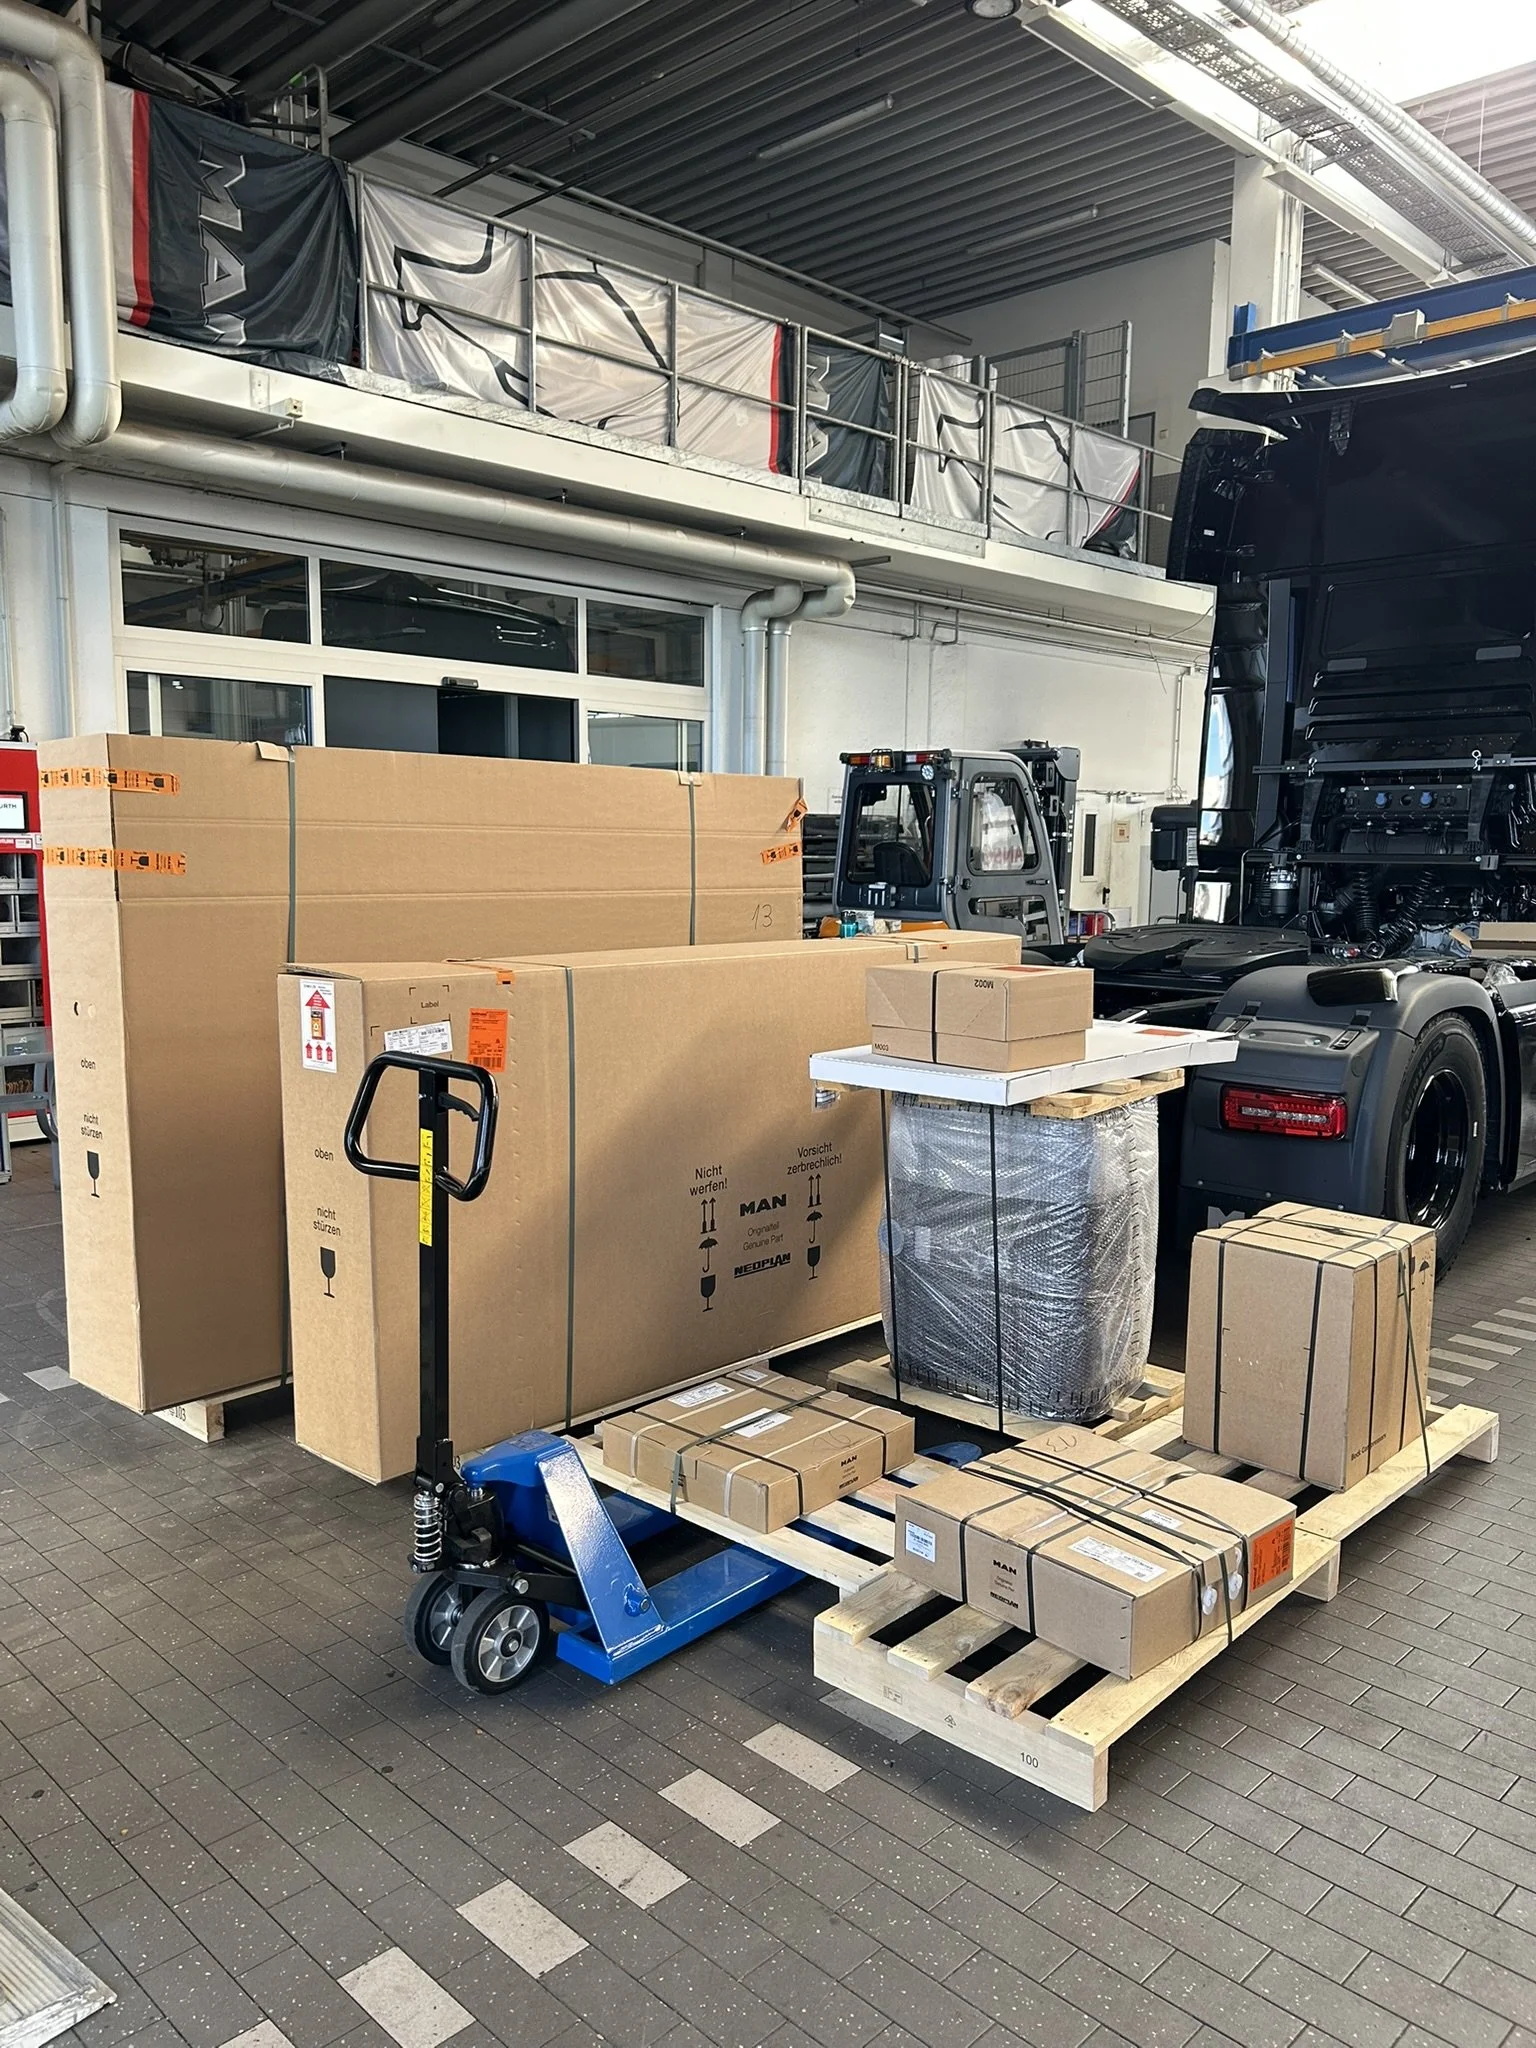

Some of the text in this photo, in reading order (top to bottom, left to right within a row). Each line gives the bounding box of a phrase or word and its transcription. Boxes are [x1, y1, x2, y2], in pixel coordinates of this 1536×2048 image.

[806, 351, 831, 476] MA
[752, 904, 773, 930] 13
[974, 979, 994, 989] M002
[420, 1000, 440, 1009] Label
[80, 1058, 96, 1070] oben
[83, 1112, 99, 1125] nicht
[81, 1125, 103, 1140] stürzen
[314, 1147, 334, 1161] oben
[797, 1142, 833, 1158] Vorsicht
[695, 1164, 723, 1180] Nicht
[787, 1153, 843, 1175] zerbrechlich!
[689, 1177, 728, 1197] werfen!
[316, 1206, 337, 1221] nicht
[740, 1194, 787, 1217] MAN
[313, 1219, 341, 1237] stürzen
[747, 1221, 780, 1237] Originalteil
[743, 1233, 784, 1251] Genuine Part
[733, 1252, 791, 1278] NEOPLAN
[841, 1454, 857, 1467] MAN
[992, 1559, 1017, 1576] MAN
[1020, 1752, 1039, 1769] 100
